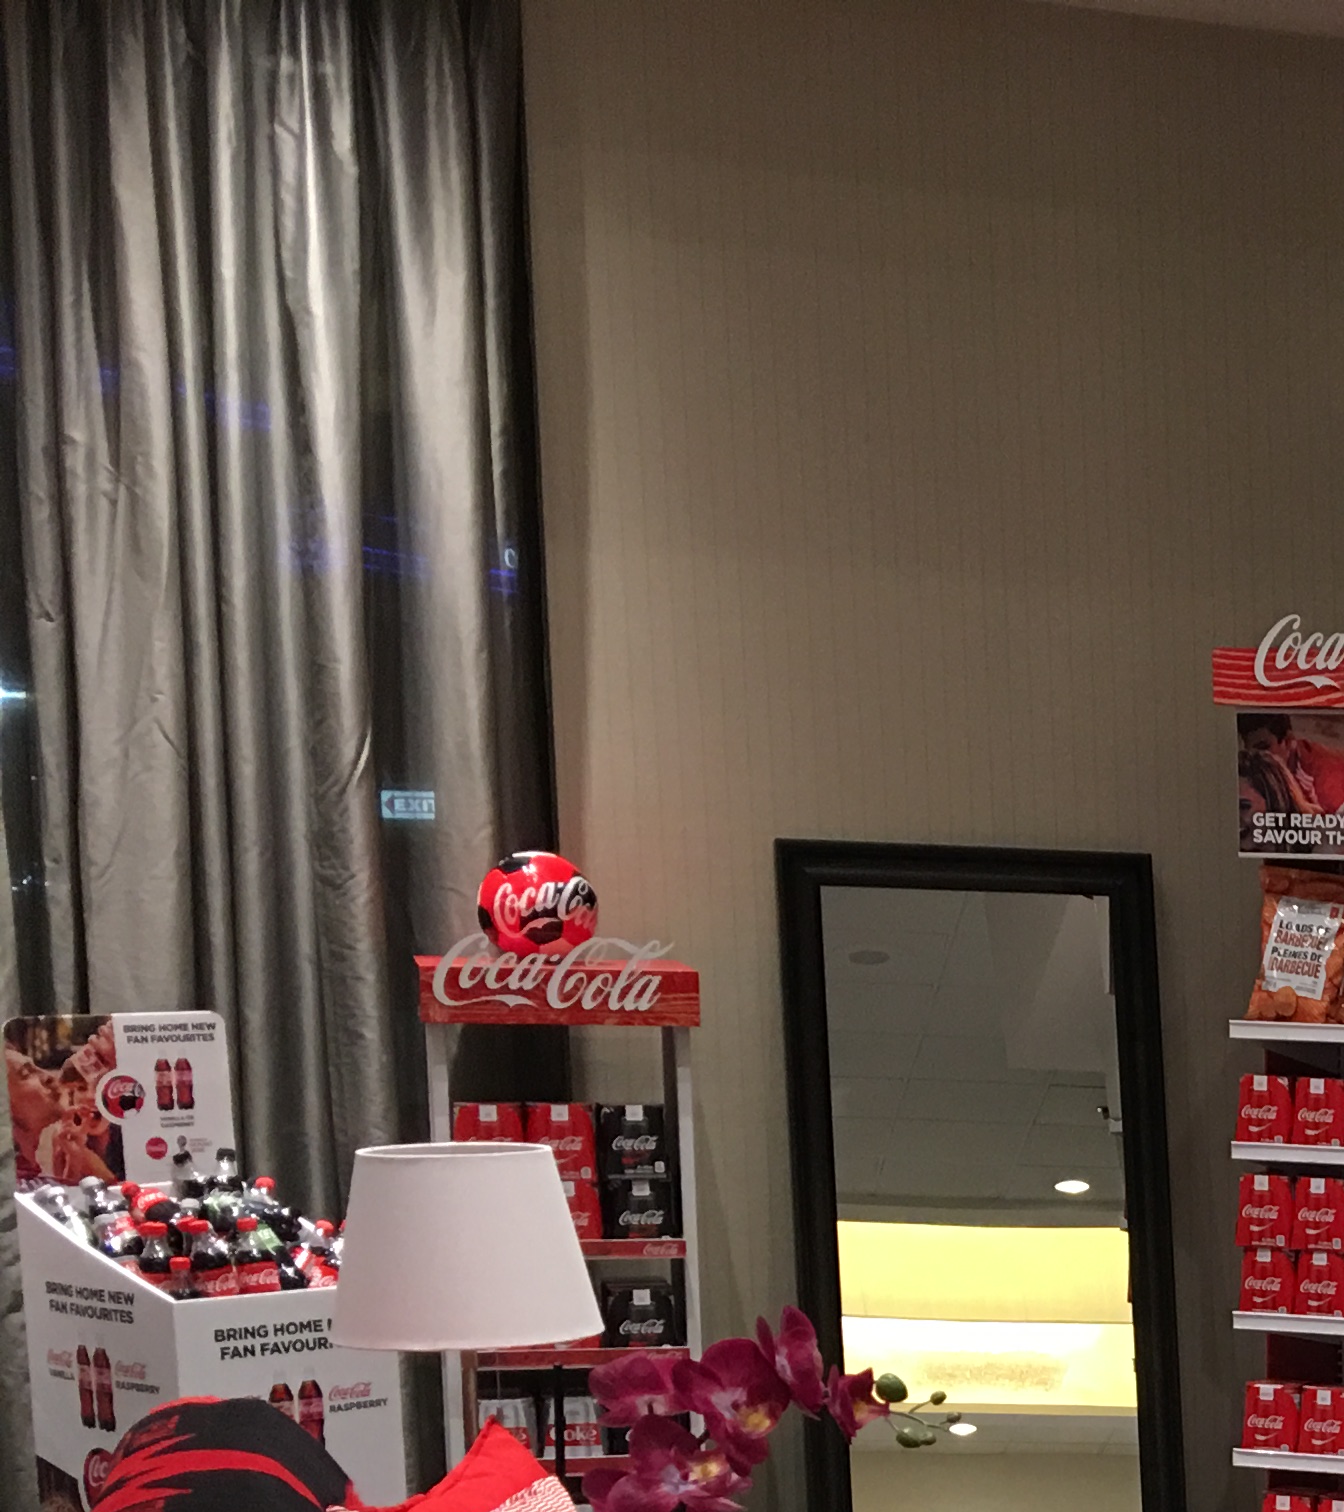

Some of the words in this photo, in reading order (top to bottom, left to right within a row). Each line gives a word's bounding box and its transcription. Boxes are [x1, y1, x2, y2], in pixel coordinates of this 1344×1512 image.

[1252, 811, 1286, 828] GET
[1252, 828, 1322, 845] SAVOUR
[431, 932, 675, 1012] Coca-Cola
[122, 1023, 156, 1034] BRING
[157, 1022, 189, 1033] HOME
[191, 1021, 217, 1032] NEW
[126, 1035, 150, 1045] FAN
[150, 1033, 216, 1044] FAVOURITES
[611, 1134, 660, 1151] Coca-Cola
[618, 1209, 665, 1226] Coca-Cola
[45, 1281, 74, 1298] BRING
[75, 1286, 106, 1303] HOME
[108, 1291, 135, 1307] NEW
[49, 1298, 69, 1314] FAN
[70, 1302, 135, 1325] FAVOURITES
[214, 1325, 269, 1343] BRING
[273, 1319, 324, 1338] HOME
[618, 1318, 666, 1336] Coca-Cola
[220, 1345, 257, 1361] FAN
[260, 1337, 334, 1357] FAVOUR
[115, 1380, 161, 1395] RASPBERRY
[328, 1382, 373, 1401] Coca-Cola
[328, 1397, 389, 1414] RASPBERRY
